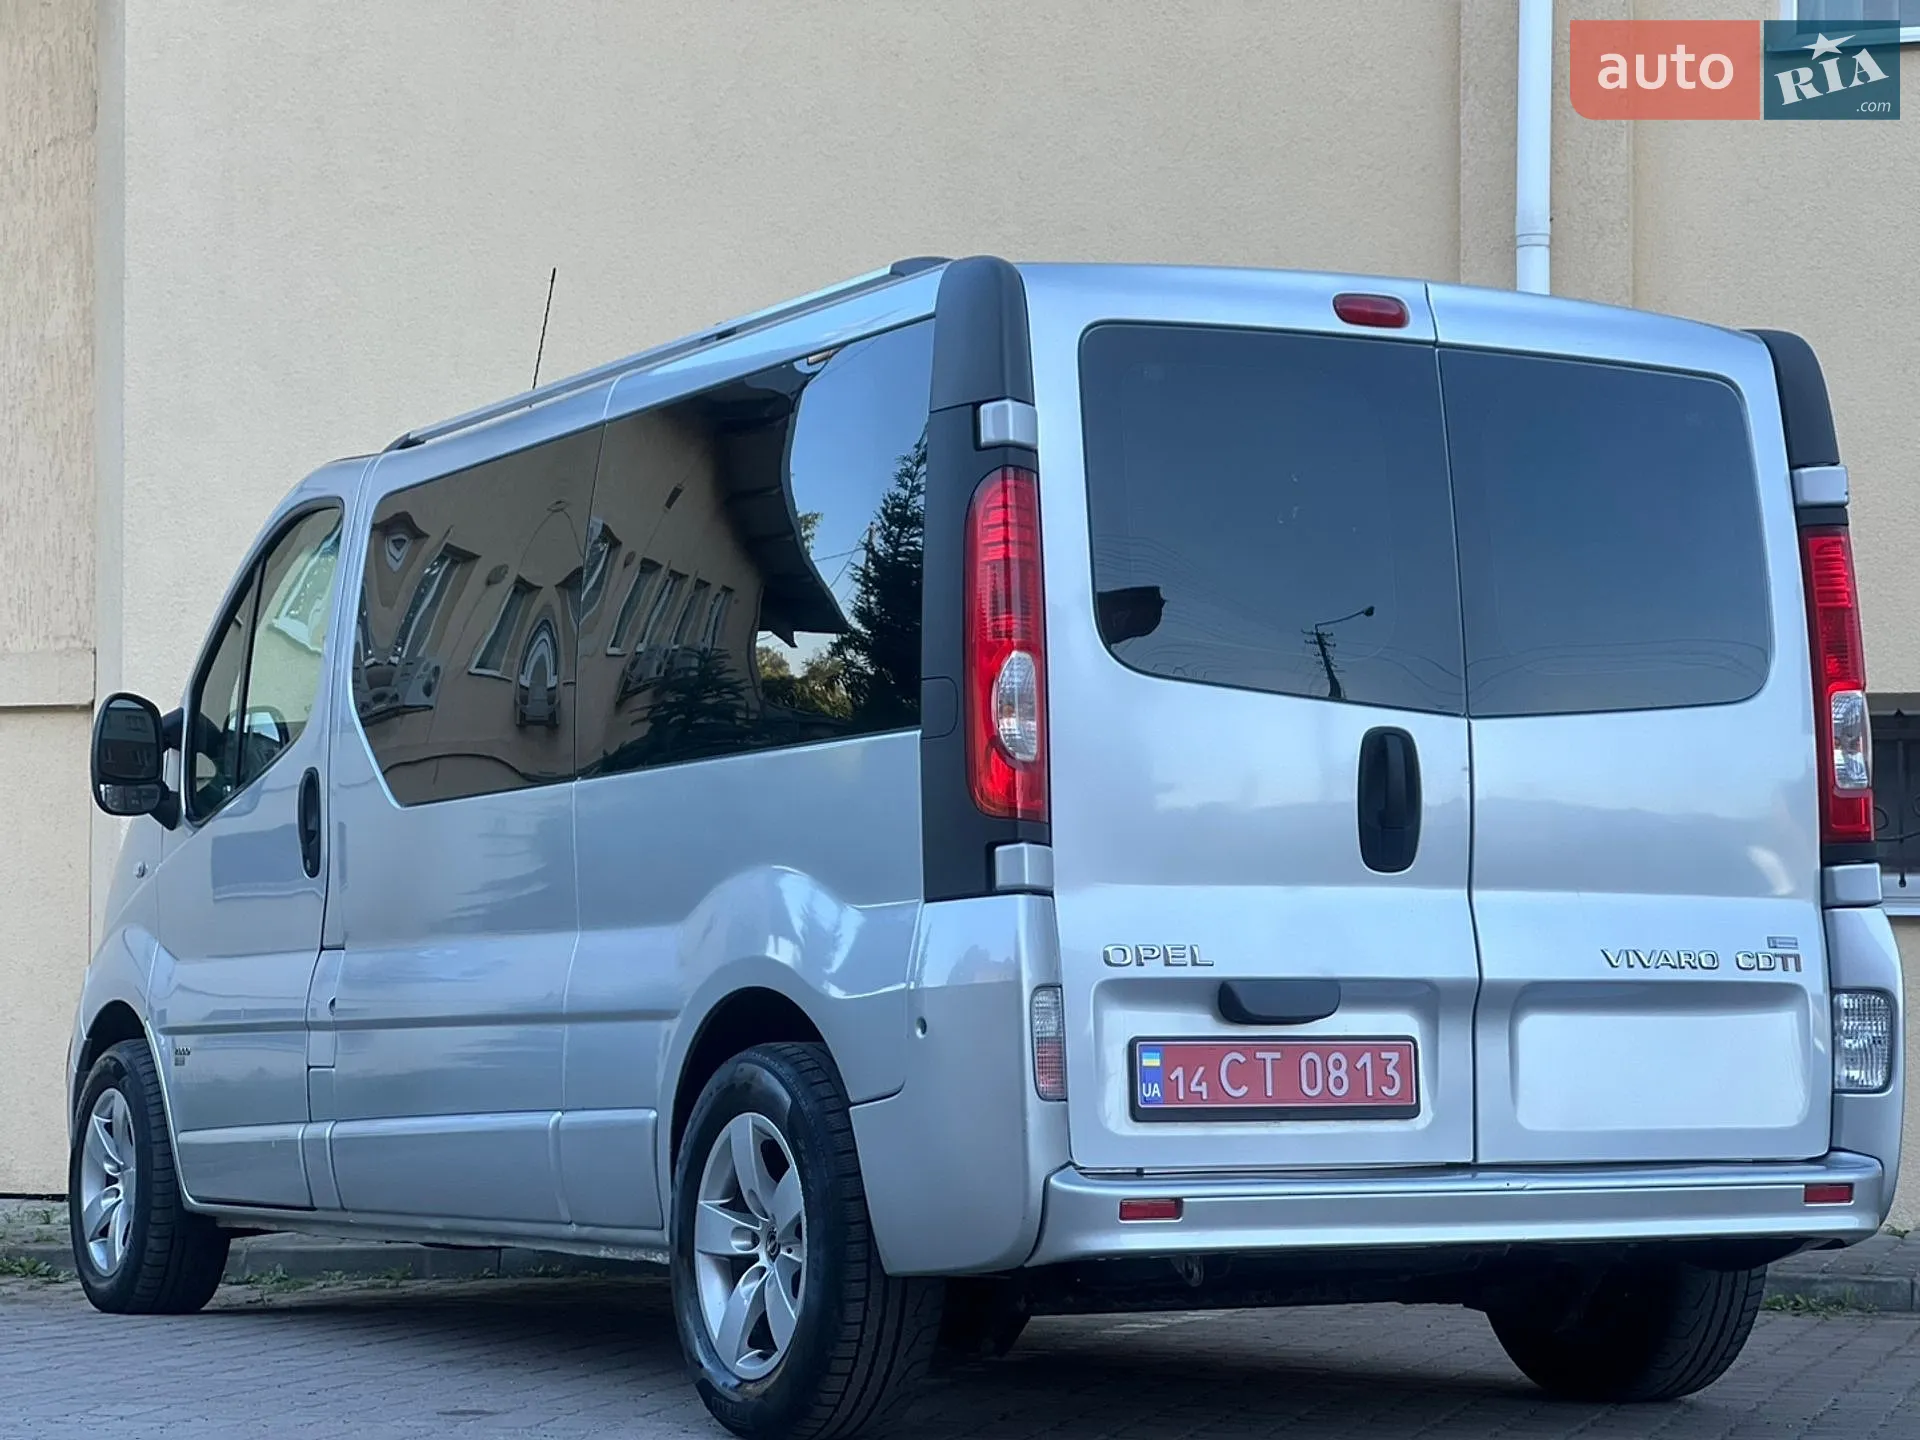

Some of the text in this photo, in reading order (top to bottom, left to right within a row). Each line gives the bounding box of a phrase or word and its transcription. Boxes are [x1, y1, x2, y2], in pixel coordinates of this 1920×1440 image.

[1102, 944, 1214, 967] OPEL
[1600, 949, 1720, 970] VIVARO
[1142, 1083, 1161, 1098] UA
